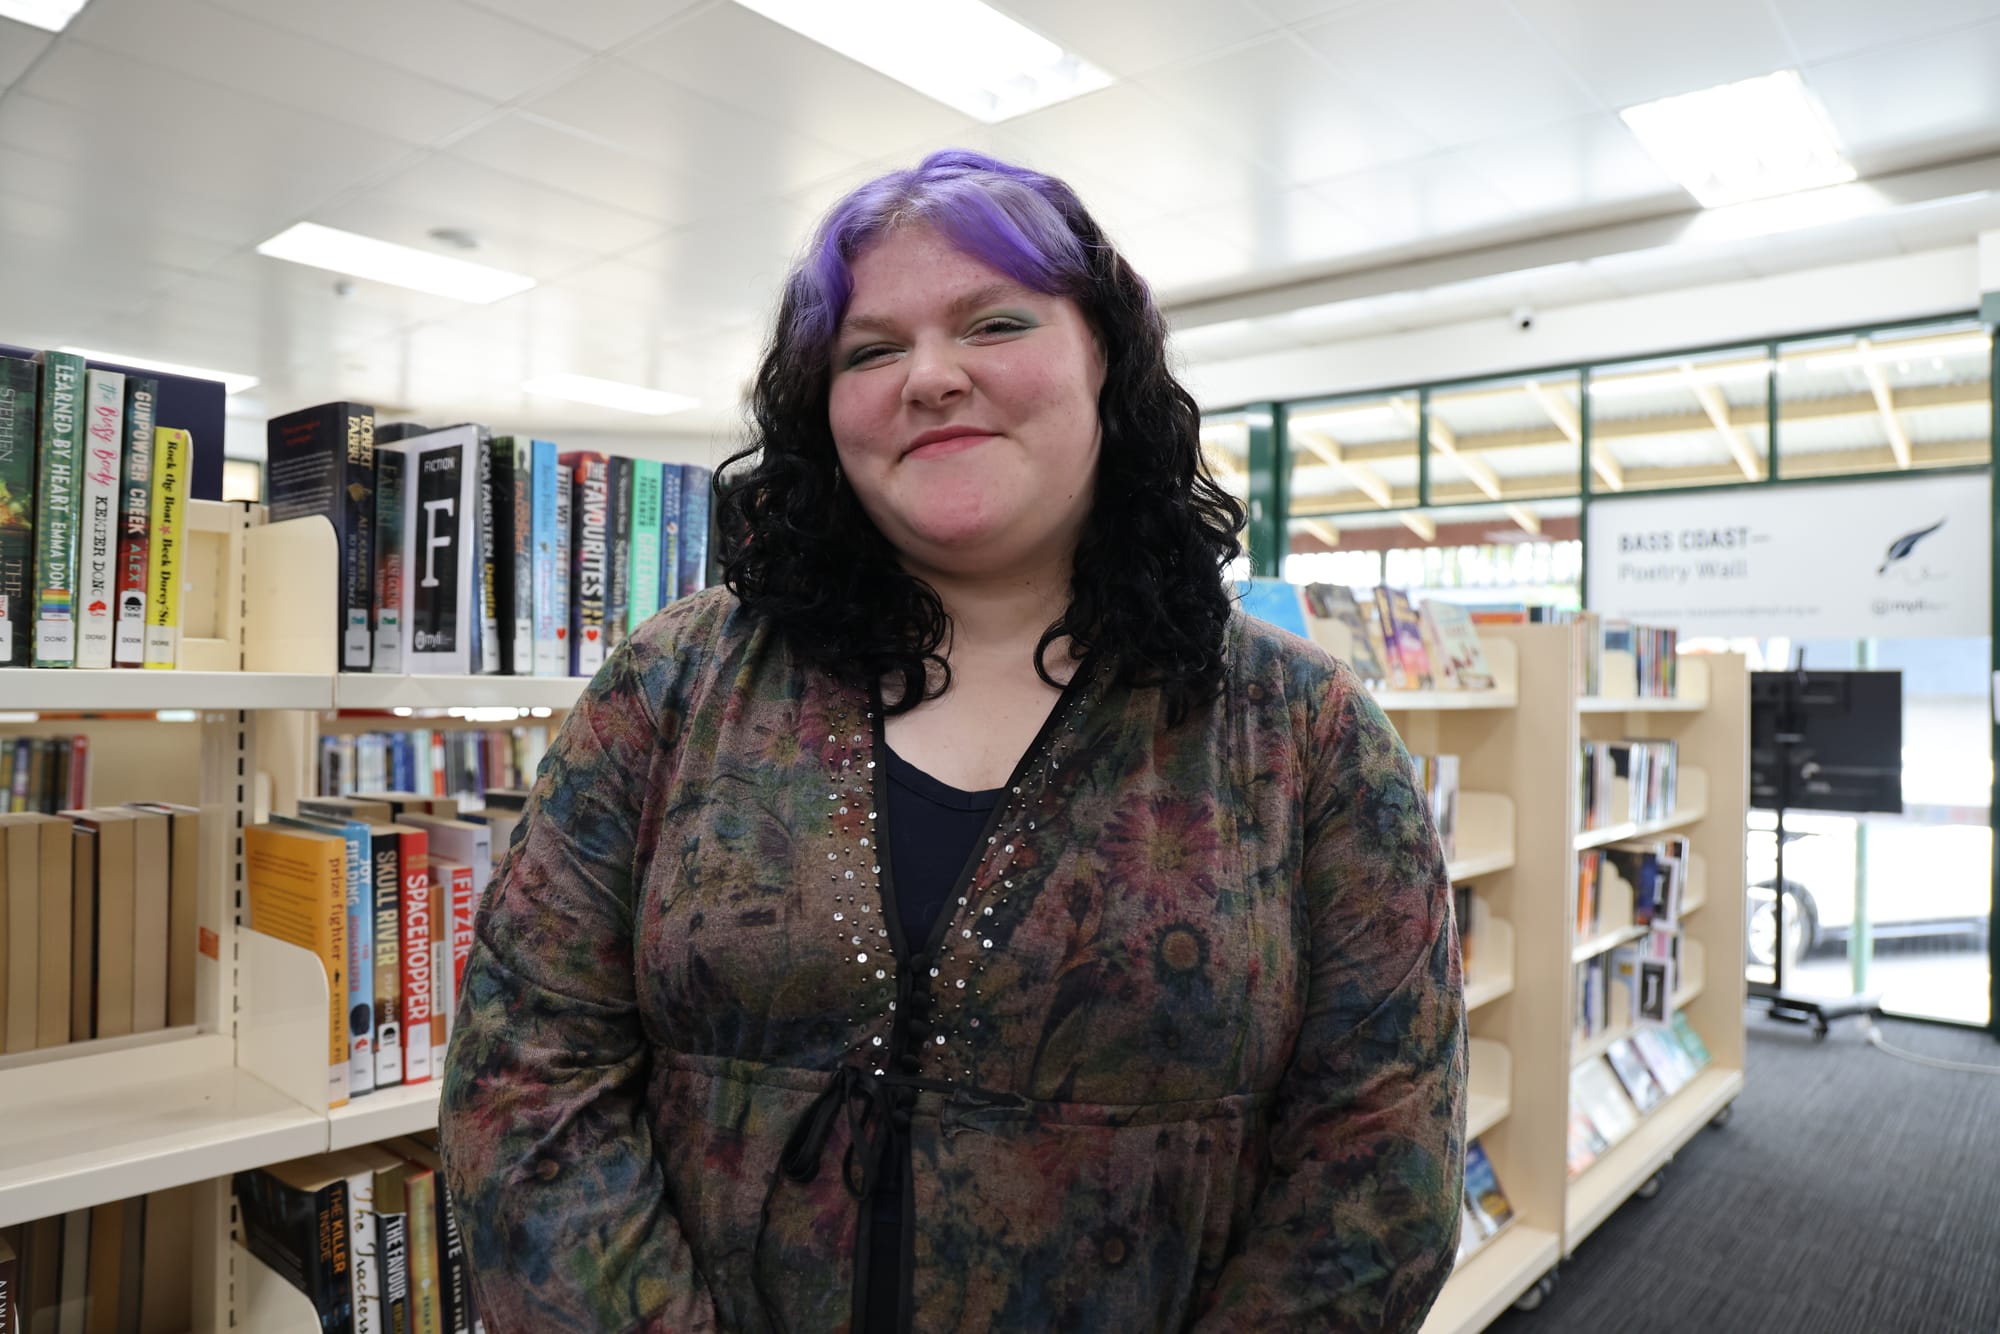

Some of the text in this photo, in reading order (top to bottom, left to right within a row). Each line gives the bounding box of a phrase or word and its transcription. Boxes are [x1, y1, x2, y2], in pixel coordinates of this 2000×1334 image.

[50, 364, 75, 513] LEARNED BY HEART
[127, 390, 152, 536] GUNPOWDER CREEK
[347, 415, 361, 466] FABBRI
[359, 415, 375, 470] ROBERT
[163, 441, 179, 525] Rock the Boat
[50, 522, 68, 560] EMMA
[93, 496, 109, 557] KEMPER
[161, 538, 174, 567] Beck
[421, 498, 455, 588] F
[581, 481, 606, 596] FAVOURITES
[1618, 531, 1673, 554] BASS
[127, 543, 141, 584] ALEX
[345, 840, 361, 906] FIELDING
[359, 858, 372, 885] JOY
[328, 858, 347, 961] prize fighter
[375, 849, 399, 967] SKULL RIVER
[453, 876, 473, 962] FITZEK
[406, 874, 429, 1021] SPACEHOPPER
[319, 1210, 332, 1263] INSIDE
[353, 1186, 375, 1233] The
[386, 1216, 404, 1248] THE
[330, 1218, 347, 1273] KILLER
[387, 1246, 407, 1304] FAVOUR
